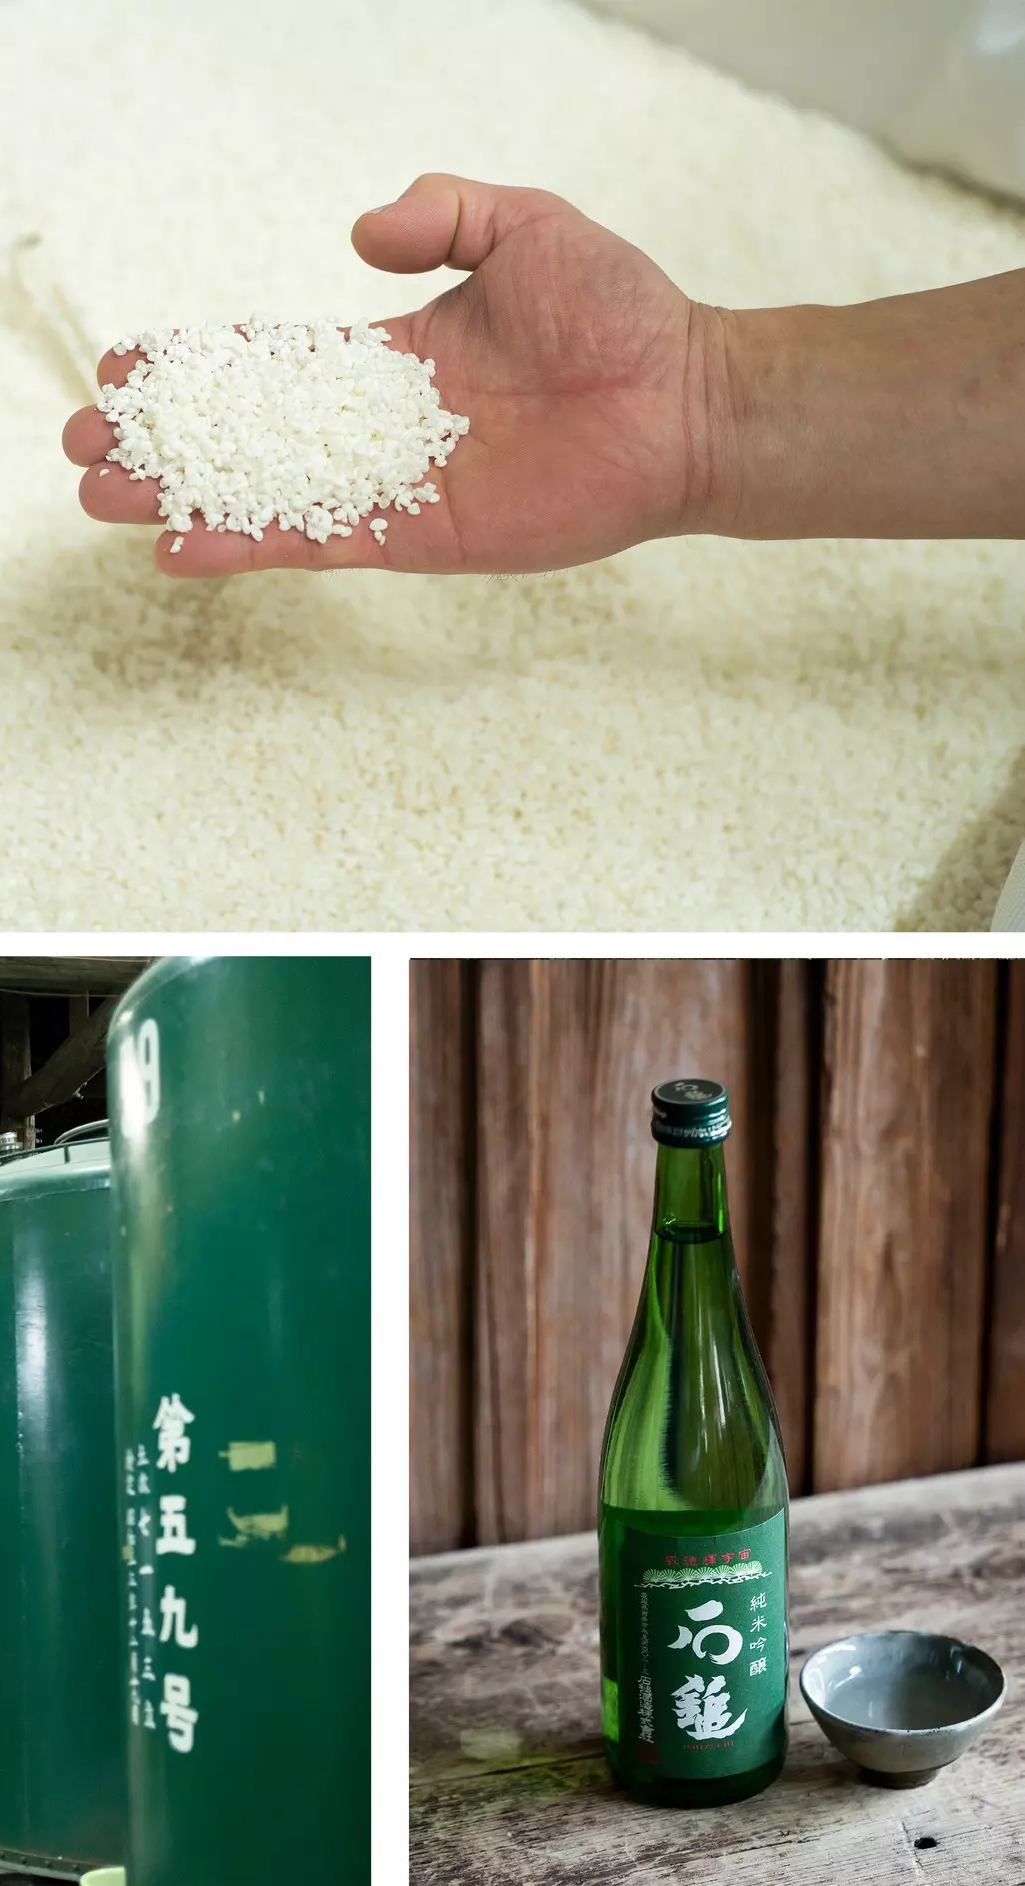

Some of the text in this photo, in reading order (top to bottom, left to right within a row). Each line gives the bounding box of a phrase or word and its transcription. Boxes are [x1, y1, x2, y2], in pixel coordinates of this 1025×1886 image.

[153, 1391, 199, 1754] 第五九号
[749, 1591, 768, 1678] 純米吟醸
[667, 1599, 749, 1741] 石鎚
